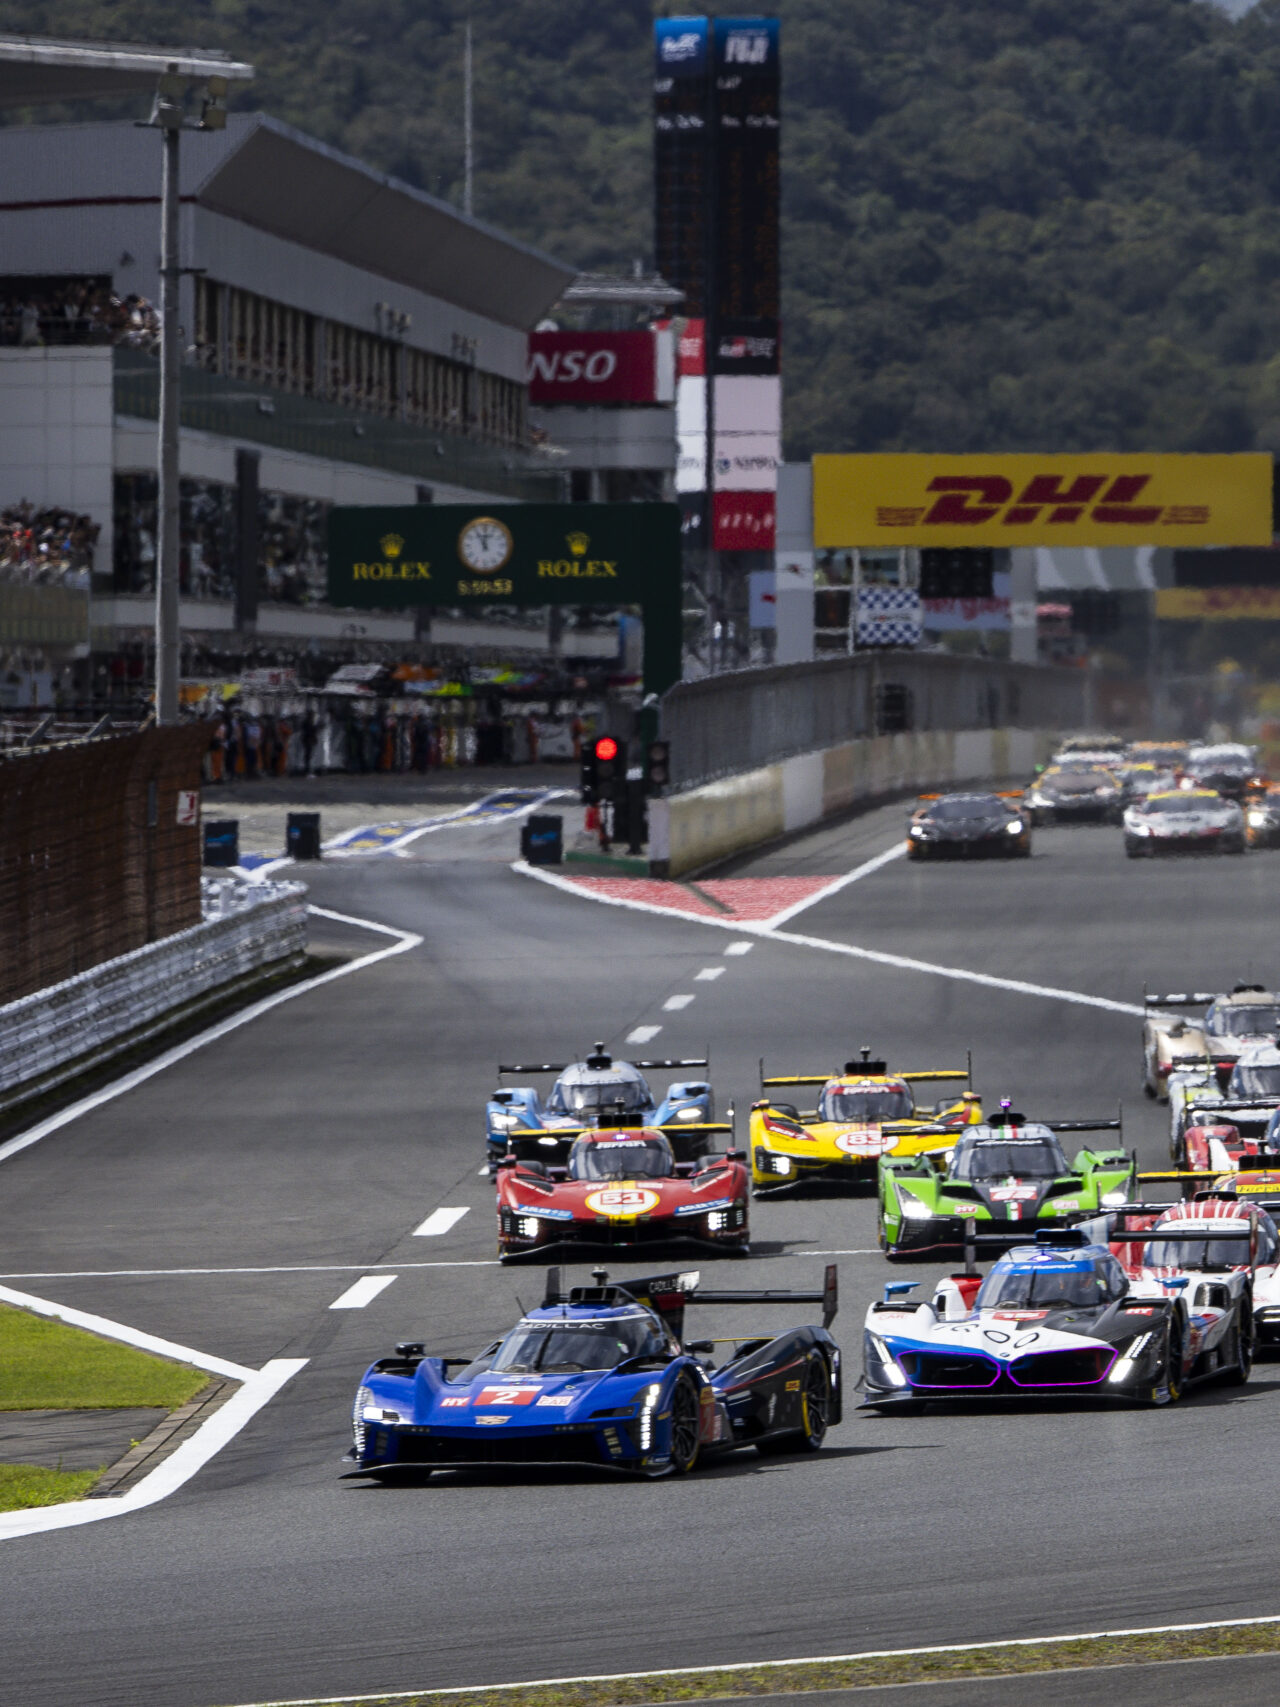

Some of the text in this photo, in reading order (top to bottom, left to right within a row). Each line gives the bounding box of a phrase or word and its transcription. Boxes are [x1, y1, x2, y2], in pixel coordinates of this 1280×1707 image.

[922, 474, 1162, 526] DHL
[352, 562, 432, 580] ROLEX
[537, 560, 618, 578] ROLEX
[602, 1193, 644, 1204] 51
[441, 1397, 469, 1406] HY
[489, 1391, 520, 1405] 2
